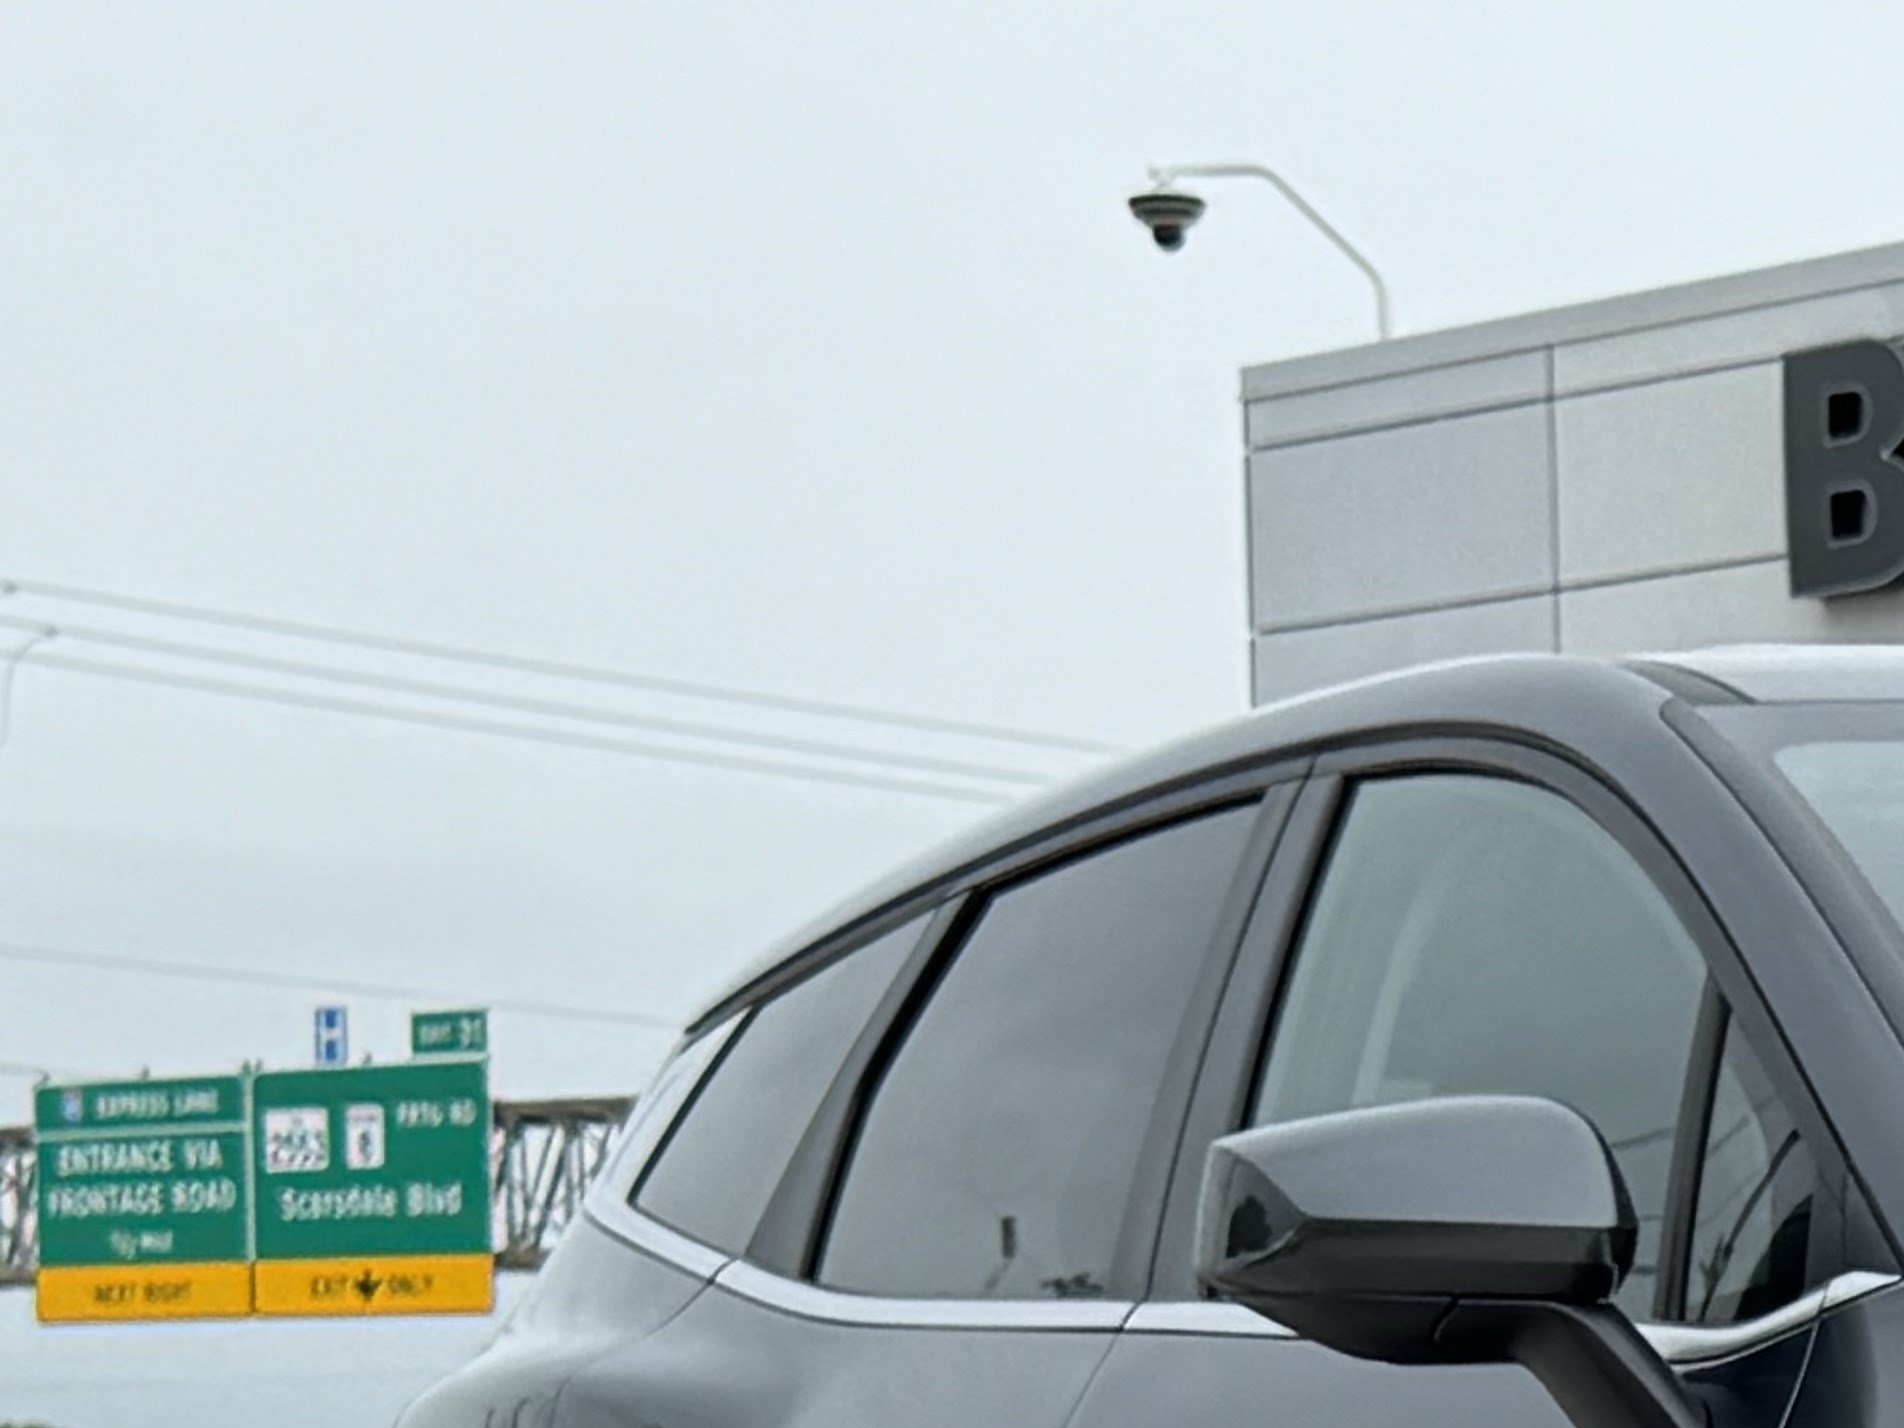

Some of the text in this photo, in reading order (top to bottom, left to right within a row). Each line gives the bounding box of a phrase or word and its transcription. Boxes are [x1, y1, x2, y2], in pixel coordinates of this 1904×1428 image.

[59, 1139, 222, 1176] ENTRANCE VIA
[48, 1180, 236, 1217] FRONTAGE ROAD
[279, 1181, 462, 1221] Scarsdale Blvd
